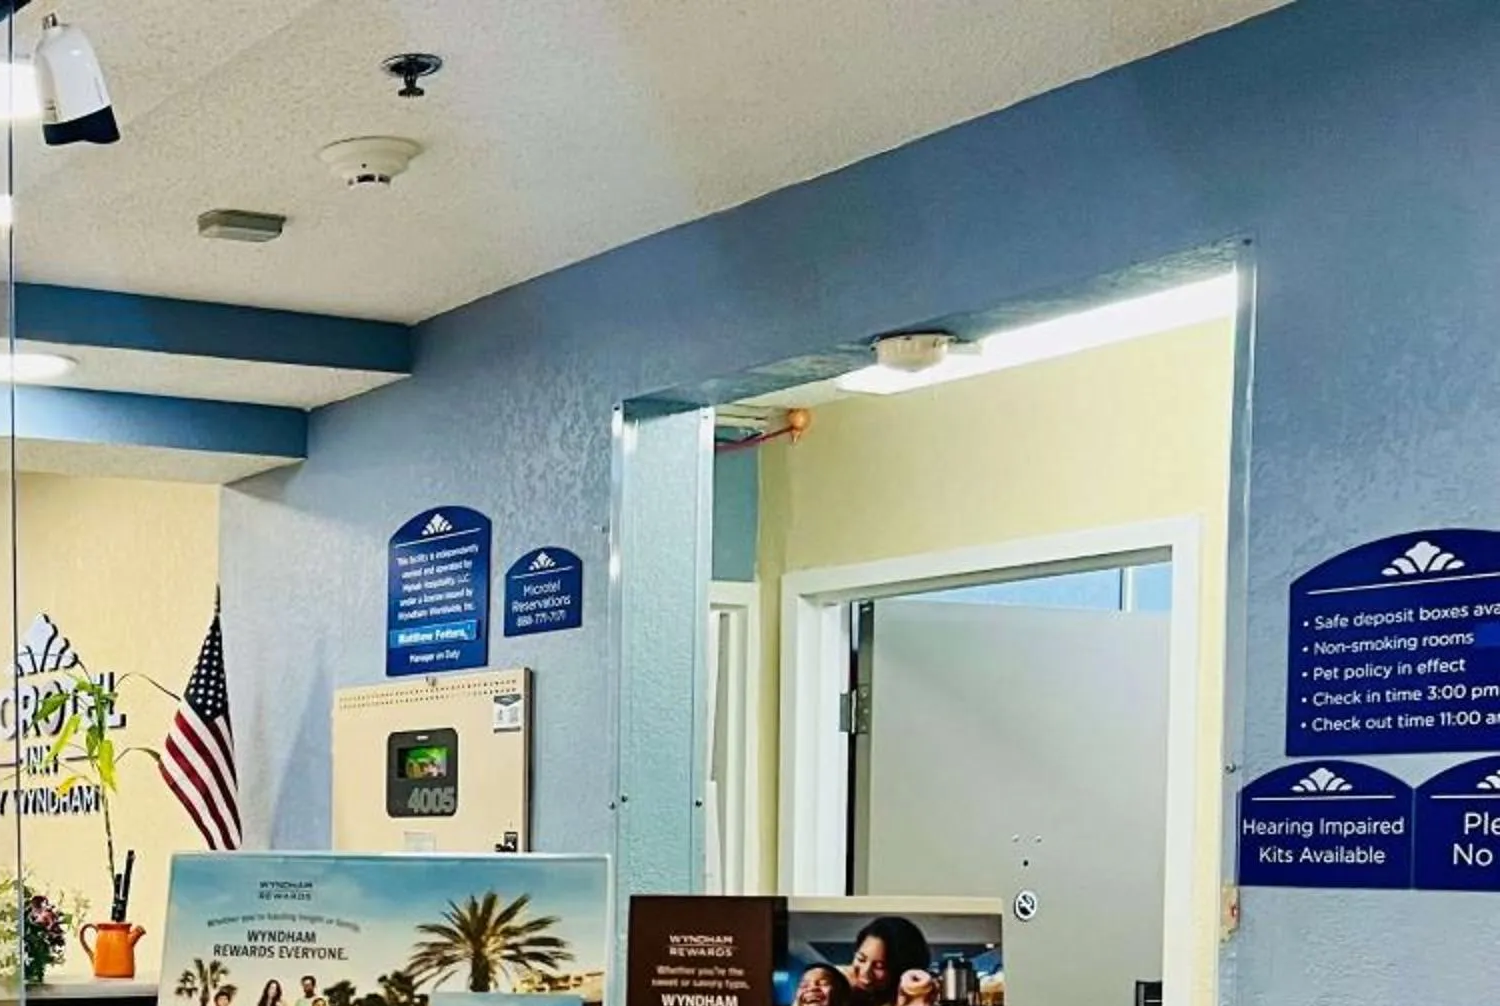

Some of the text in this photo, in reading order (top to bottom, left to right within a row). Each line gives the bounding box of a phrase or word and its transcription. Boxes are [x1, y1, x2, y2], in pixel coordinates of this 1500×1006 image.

[523, 579, 561, 597] Microtel
[512, 594, 572, 614] Reservations
[1314, 613, 1350, 630] Safe
[1353, 608, 1415, 628] deposit
[1419, 604, 1470, 621] boxes
[1313, 631, 1475, 656] Non-smoking rooms
[1313, 657, 1467, 681] Pet policy in effect
[1312, 684, 1500, 707] Check in time 3:00 pm
[1311, 715, 1361, 732] Check
[1365, 714, 1393, 729] out
[1397, 713, 1435, 729] time
[1439, 710, 1481, 726] 11:00
[407, 785, 455, 814] 4005
[1243, 816, 1405, 838] Hearing Impaired
[1259, 844, 1387, 864] Kits Available
[1453, 842, 1494, 867] No
[246, 929, 318, 944] WYNDHAM
[668, 934, 734, 945] WYNDHAM
[213, 943, 349, 961] REWARDS EVERYONE.
[668, 946, 734, 958] REWARDS
